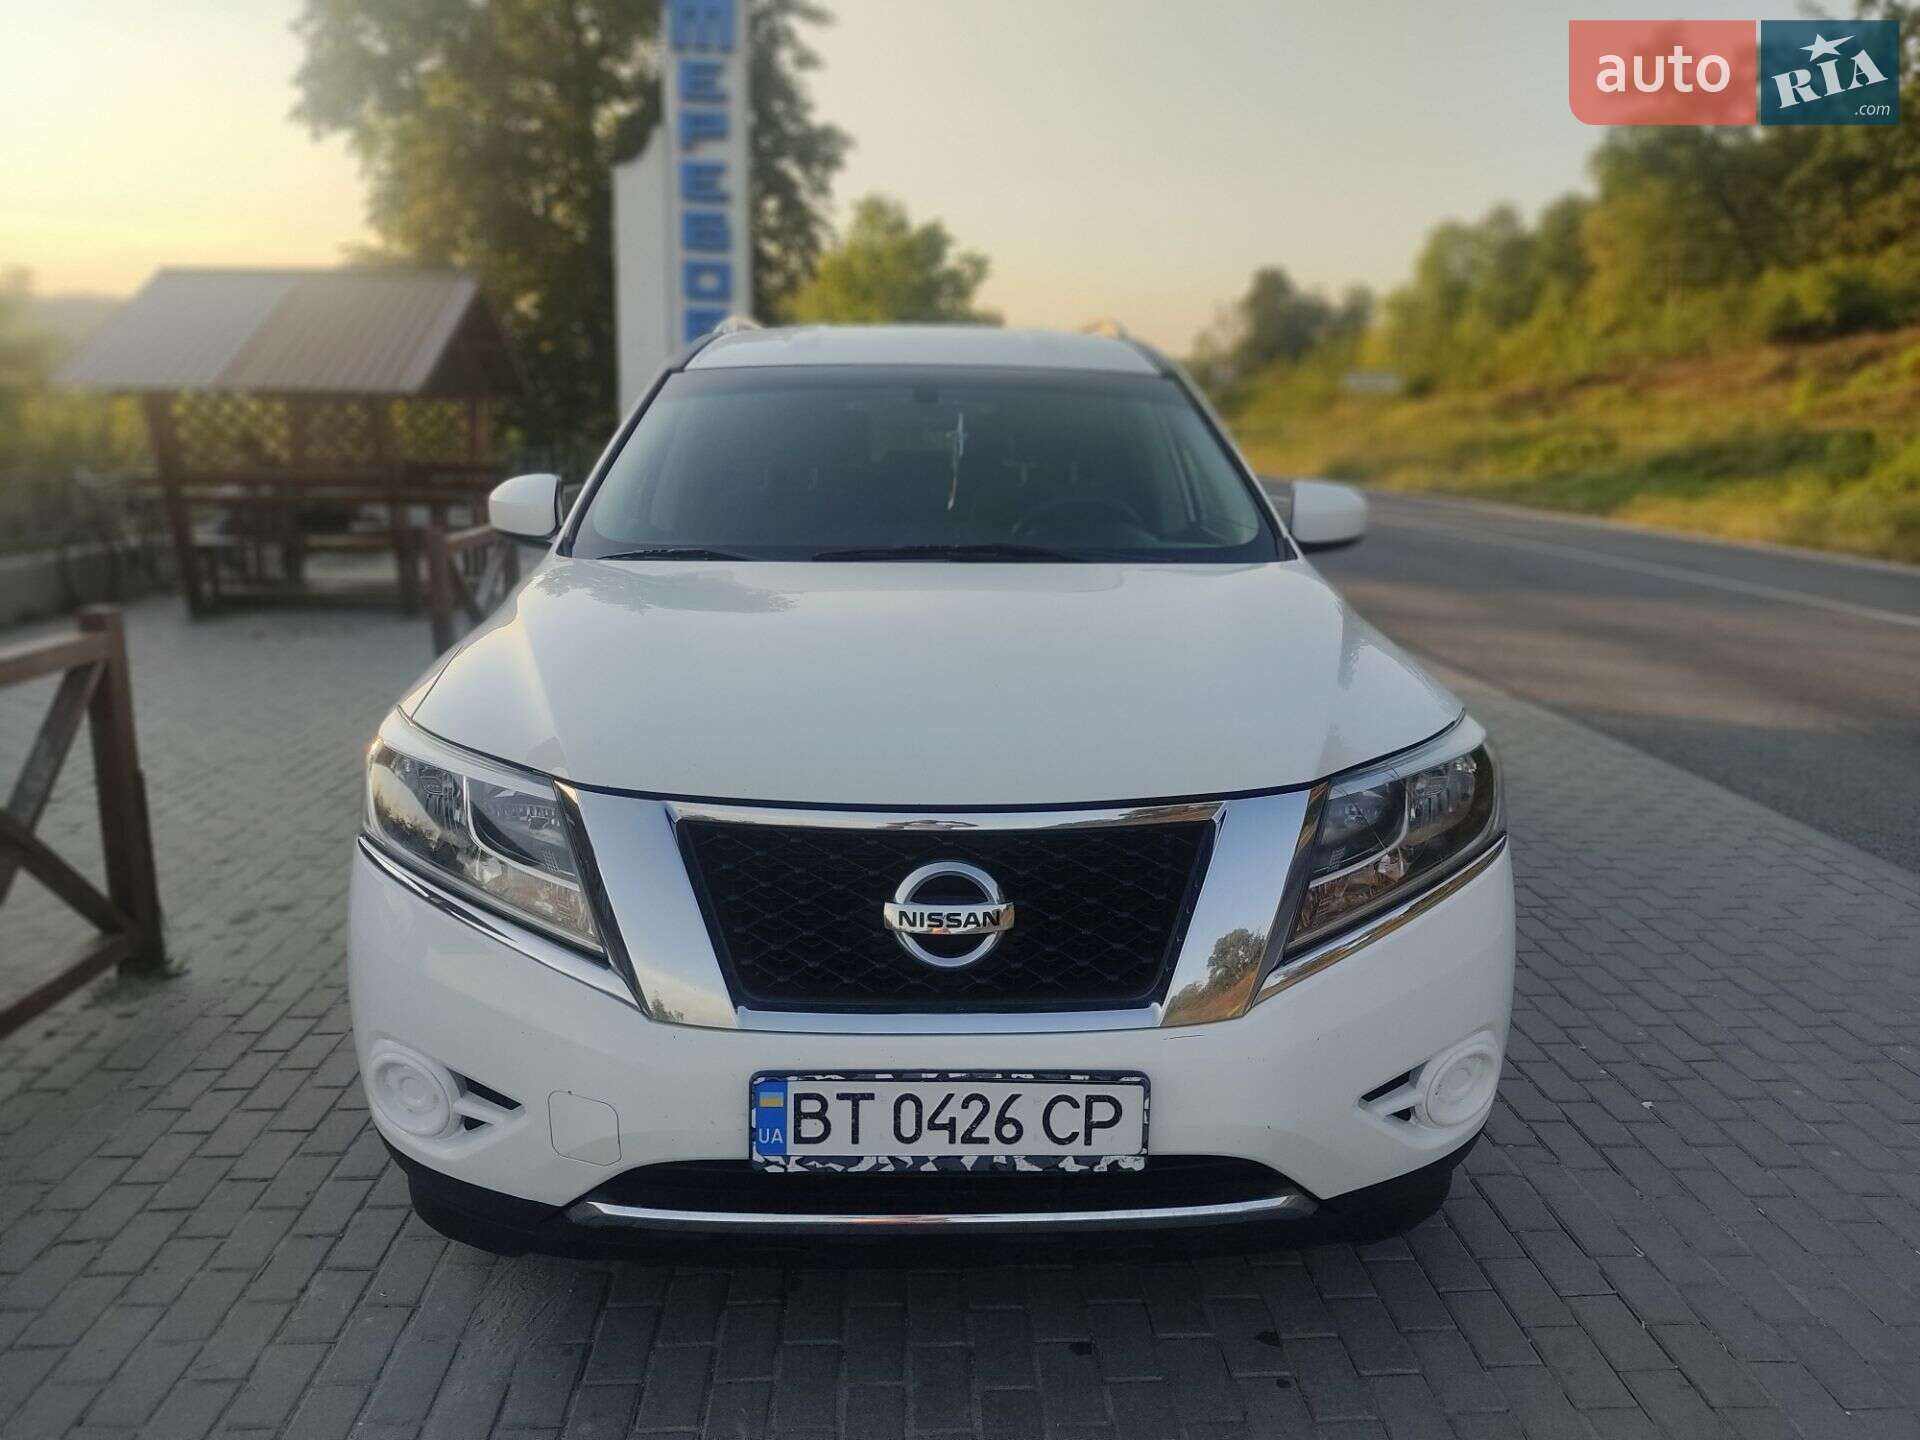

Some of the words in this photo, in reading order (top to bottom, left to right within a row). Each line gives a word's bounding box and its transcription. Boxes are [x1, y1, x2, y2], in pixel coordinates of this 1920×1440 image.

[898, 910, 1001, 928] NISSAN
[793, 1092, 876, 1145] BT
[893, 1093, 1025, 1145] 0426
[1041, 1094, 1123, 1146] CP
[758, 1127, 784, 1145] UA
